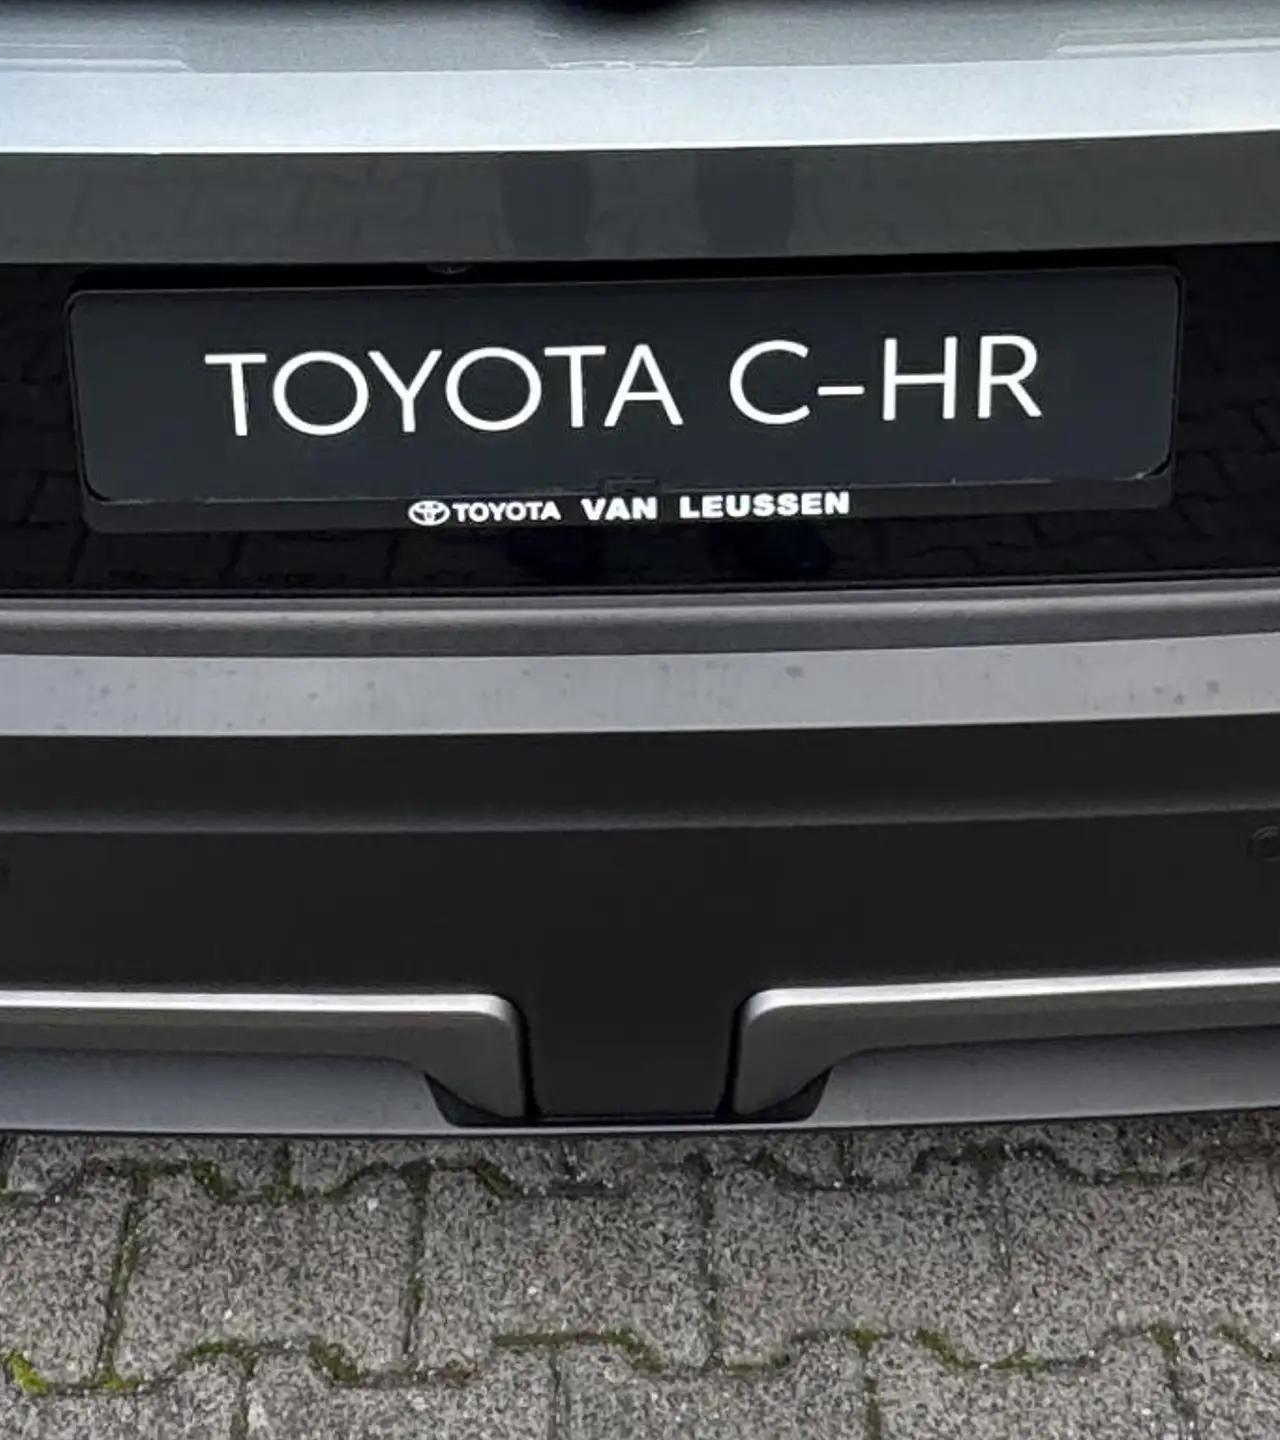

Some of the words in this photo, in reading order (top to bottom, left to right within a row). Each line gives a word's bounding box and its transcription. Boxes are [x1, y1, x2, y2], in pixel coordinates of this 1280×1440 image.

[204, 343, 685, 437] TOYOTA
[729, 334, 1043, 426] C-HR
[452, 500, 562, 523] TOYOTA
[581, 496, 657, 521] VAN
[679, 491, 851, 519] LEUSSEN
